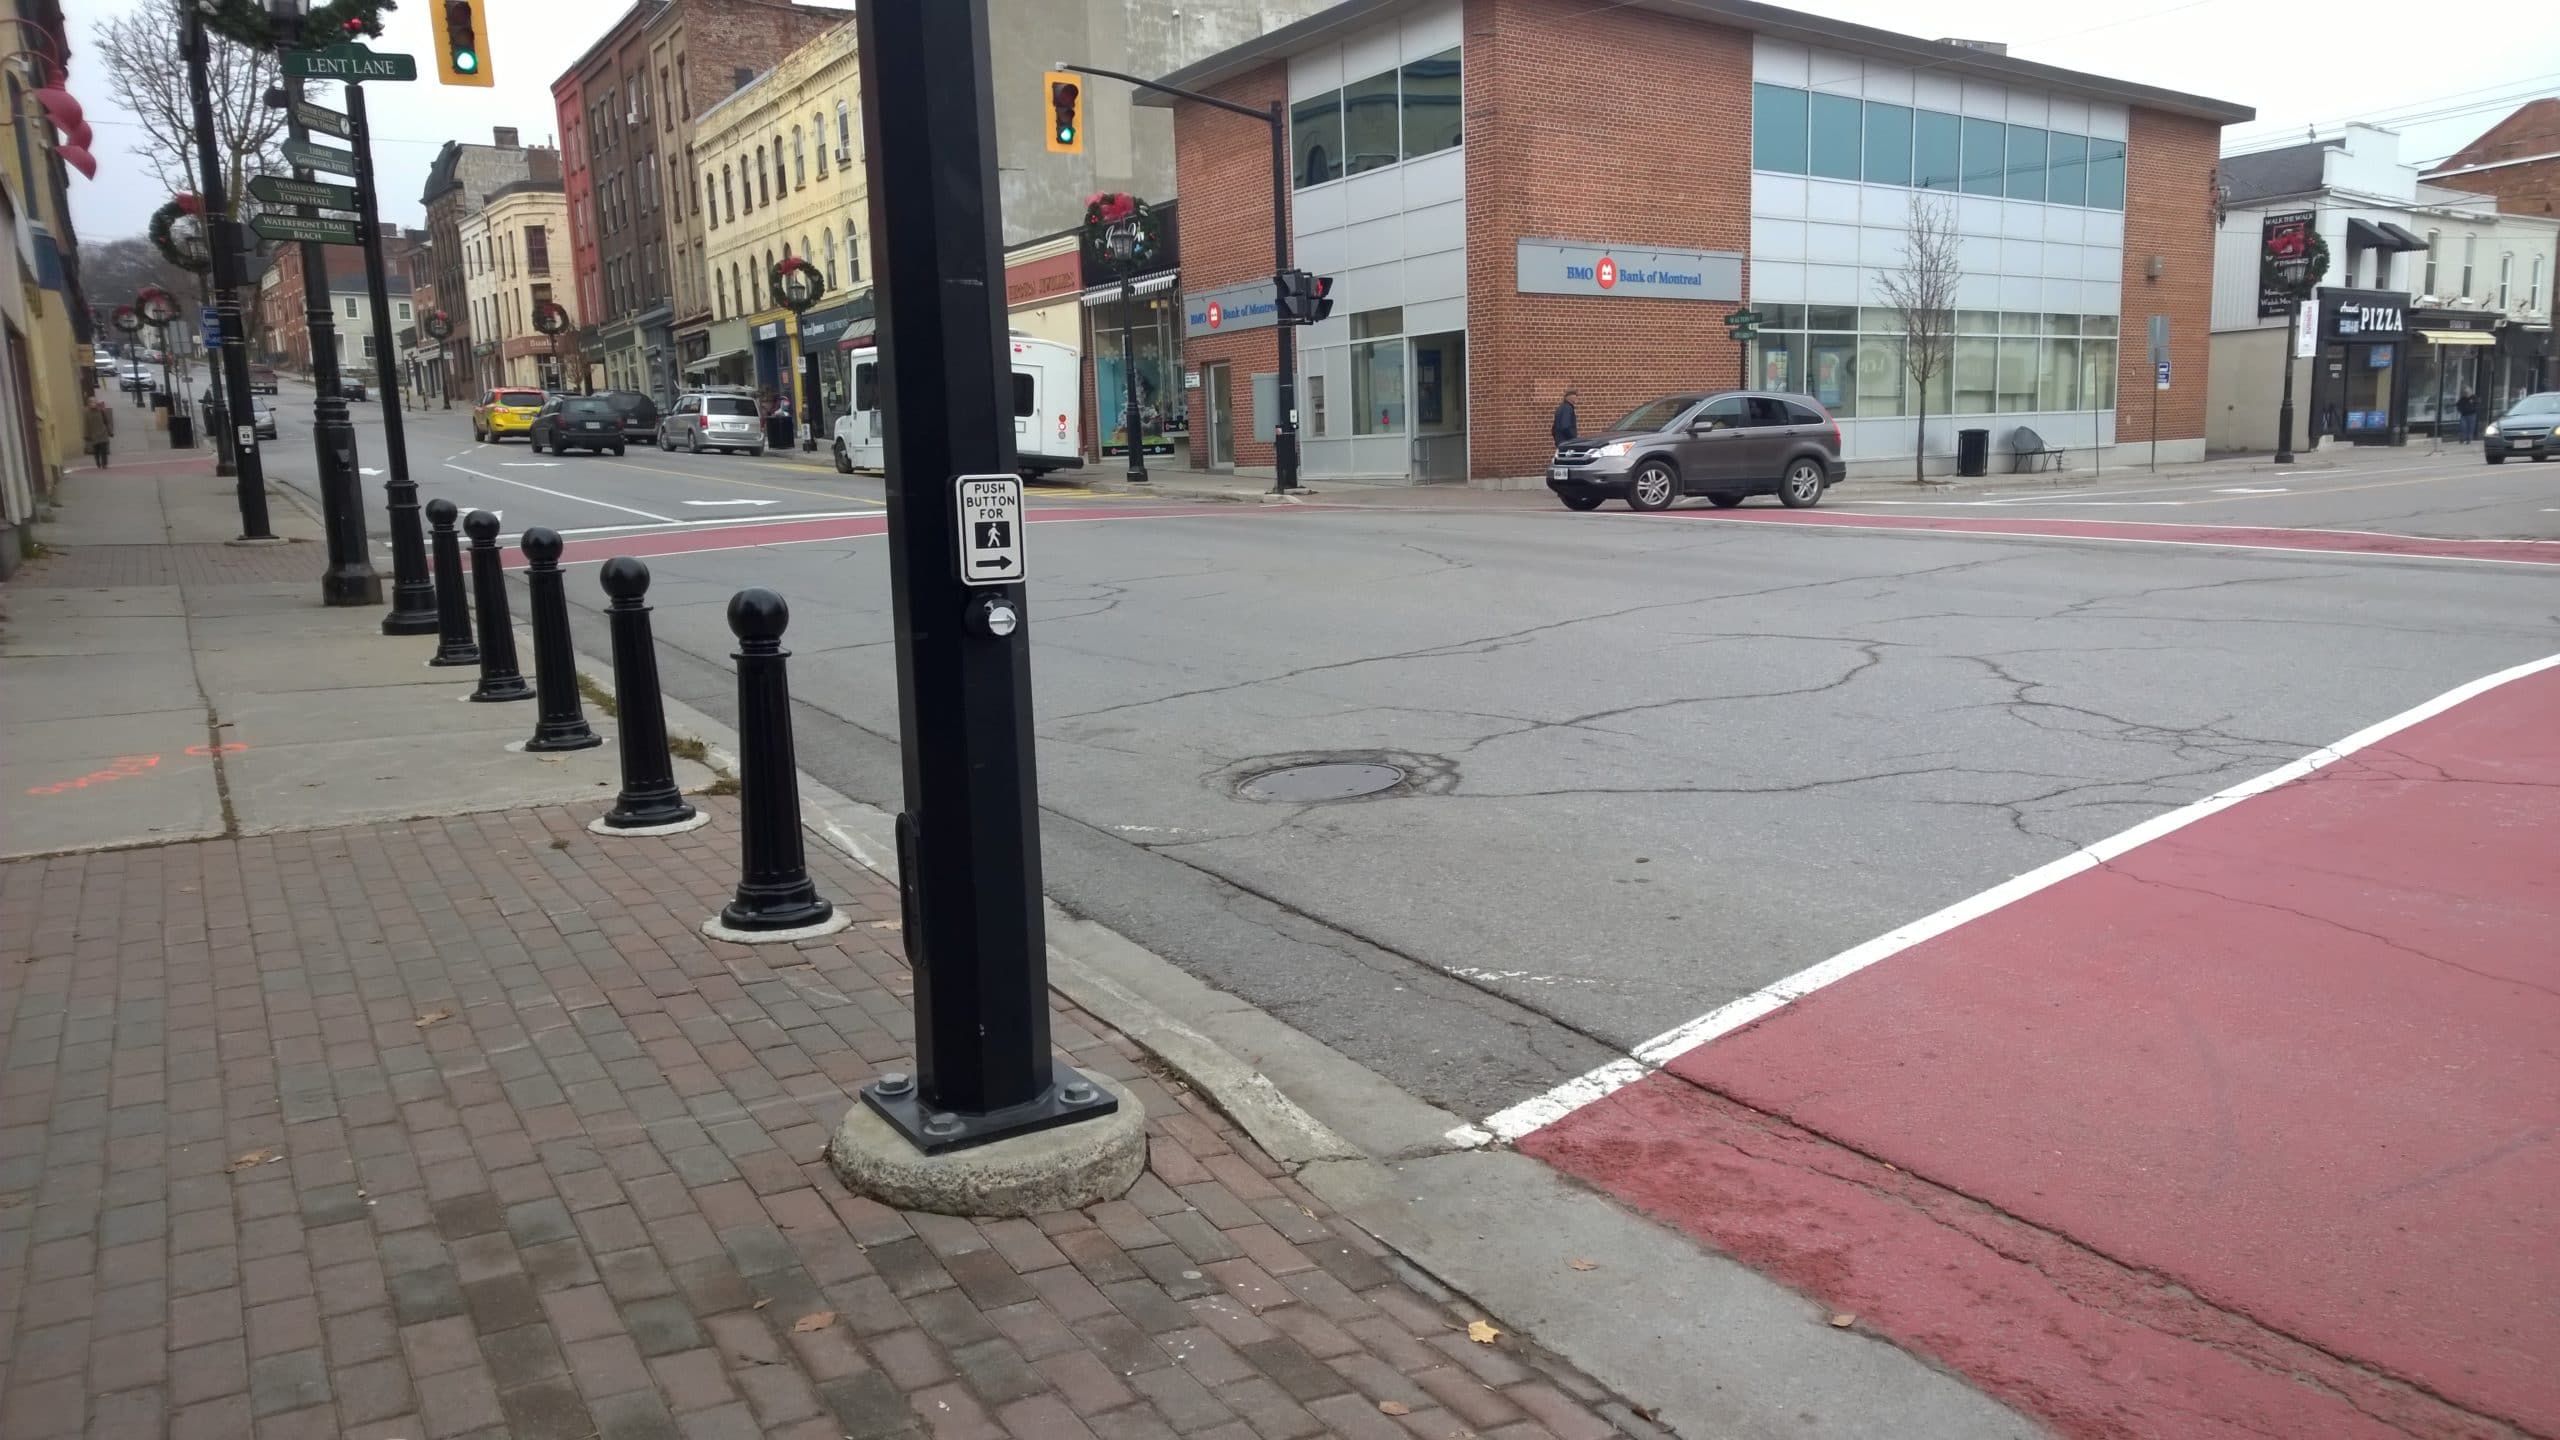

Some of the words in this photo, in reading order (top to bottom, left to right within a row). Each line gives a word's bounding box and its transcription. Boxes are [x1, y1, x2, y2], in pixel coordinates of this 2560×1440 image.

[306, 57, 348, 73] LENT
[352, 59, 396, 75] LANE
[274, 180, 331, 195] WASHROOMS
[280, 193, 308, 204] TOWN
[309, 196, 330, 206] HALL
[263, 216, 320, 229] WATERFRONT
[320, 221, 346, 232] TRAIL
[293, 230, 322, 240] BEACH
[1566, 265, 1594, 281] BMO
[1619, 269, 1645, 283] Bank
[1647, 270, 1657, 283] of
[1659, 272, 1702, 286] Montreal
[1190, 312, 1207, 326] BMO
[1222, 307, 1240, 320] Bank
[1240, 304, 1248, 317] of
[2360, 307, 2403, 331] PIZZA
[974, 483, 1006, 494] PUSH
[966, 496, 1016, 508] BUTTON
[980, 508, 1004, 519] FOR
